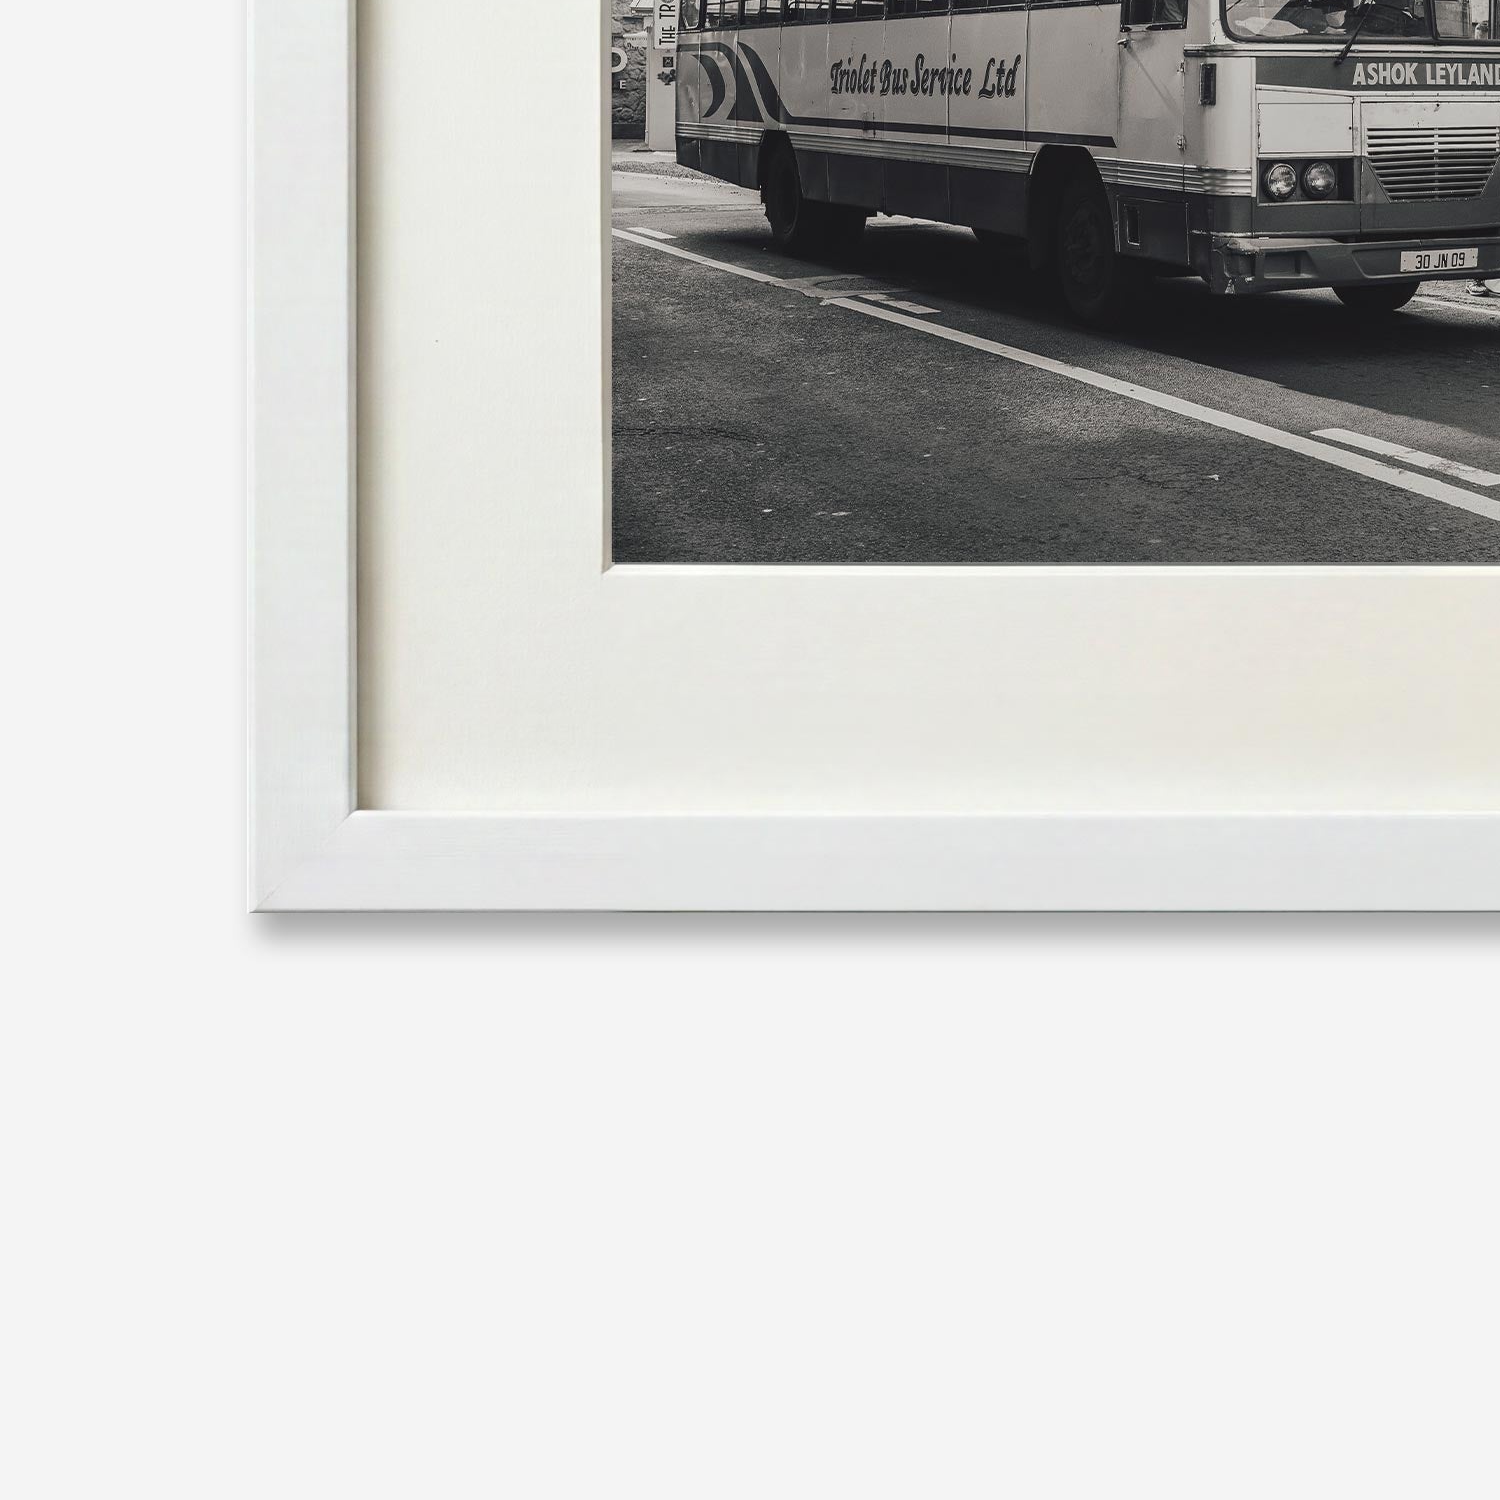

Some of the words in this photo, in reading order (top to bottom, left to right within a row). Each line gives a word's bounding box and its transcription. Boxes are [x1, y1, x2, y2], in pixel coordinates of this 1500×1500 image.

[659, 25, 677, 46] THE
[830, 53, 877, 95] Triolet
[879, 58, 909, 97] Bus
[910, 53, 972, 97] Service
[977, 53, 1022, 100] Ltd
[1352, 62, 1419, 86] ASHOK
[1415, 254, 1431, 270] 30
[1433, 253, 1449, 269] JN
[1451, 252, 1466, 268] 09
